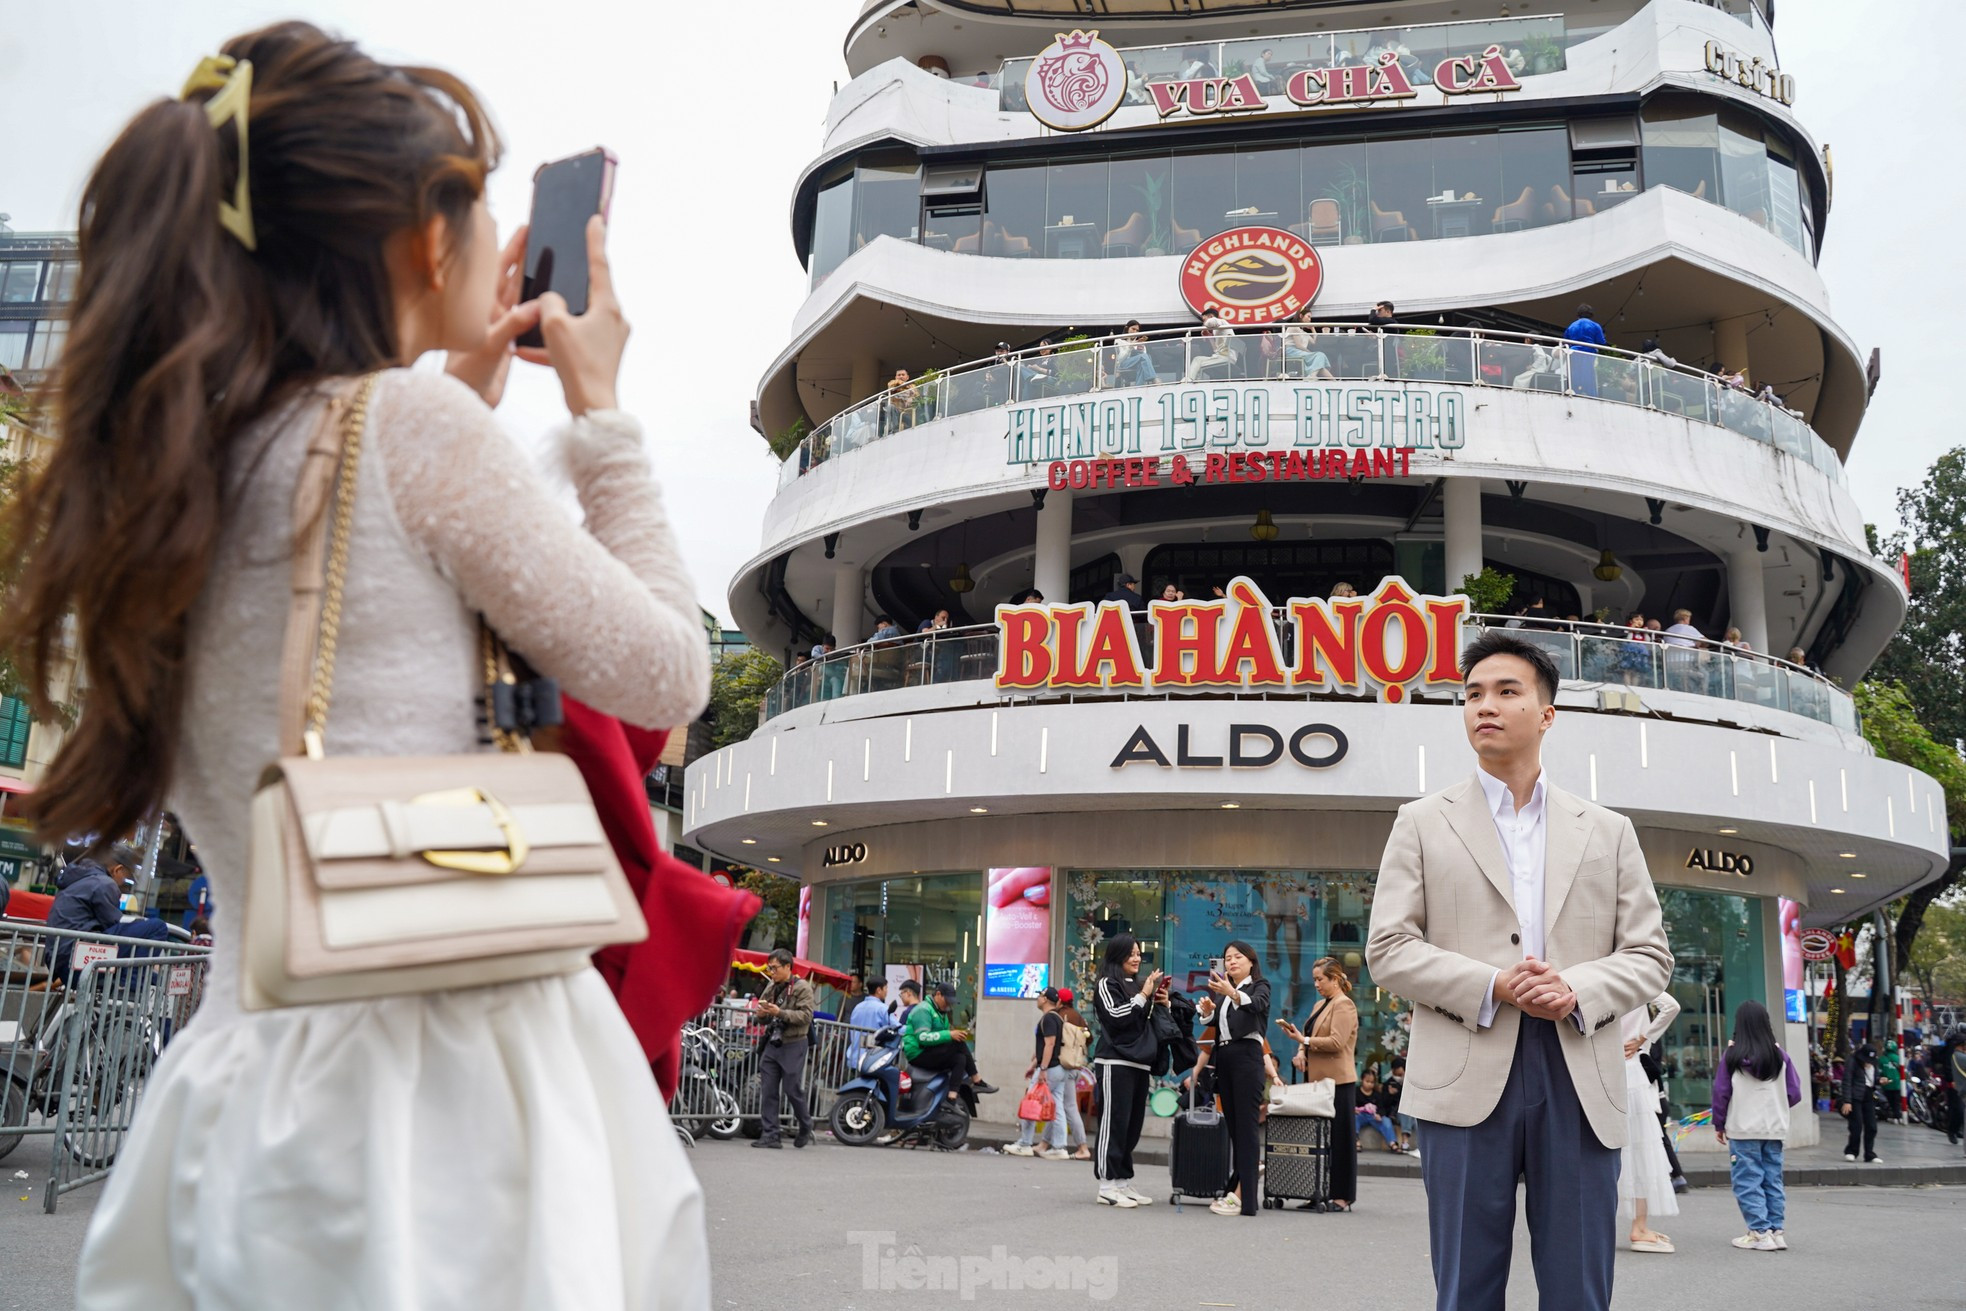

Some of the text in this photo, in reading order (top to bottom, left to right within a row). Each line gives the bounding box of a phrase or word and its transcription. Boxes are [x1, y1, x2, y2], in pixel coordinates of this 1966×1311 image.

[1146, 44, 1522, 118] VUA CHẢ CÁ
[1187, 232, 1314, 277] HIGHLANDS
[1203, 294, 1301, 322] COFFEE
[1007, 388, 1465, 465] HANOI 1930 BISTRO
[1048, 448, 1415, 491] COFFEE & RESTAURANT
[996, 580, 1464, 704] BIA HÀ NỘI
[1109, 723, 1349, 769] ALDO
[823, 842, 868, 867] ALDO
[1685, 848, 1754, 876] ALDO
[83, 955, 108, 965] ST
